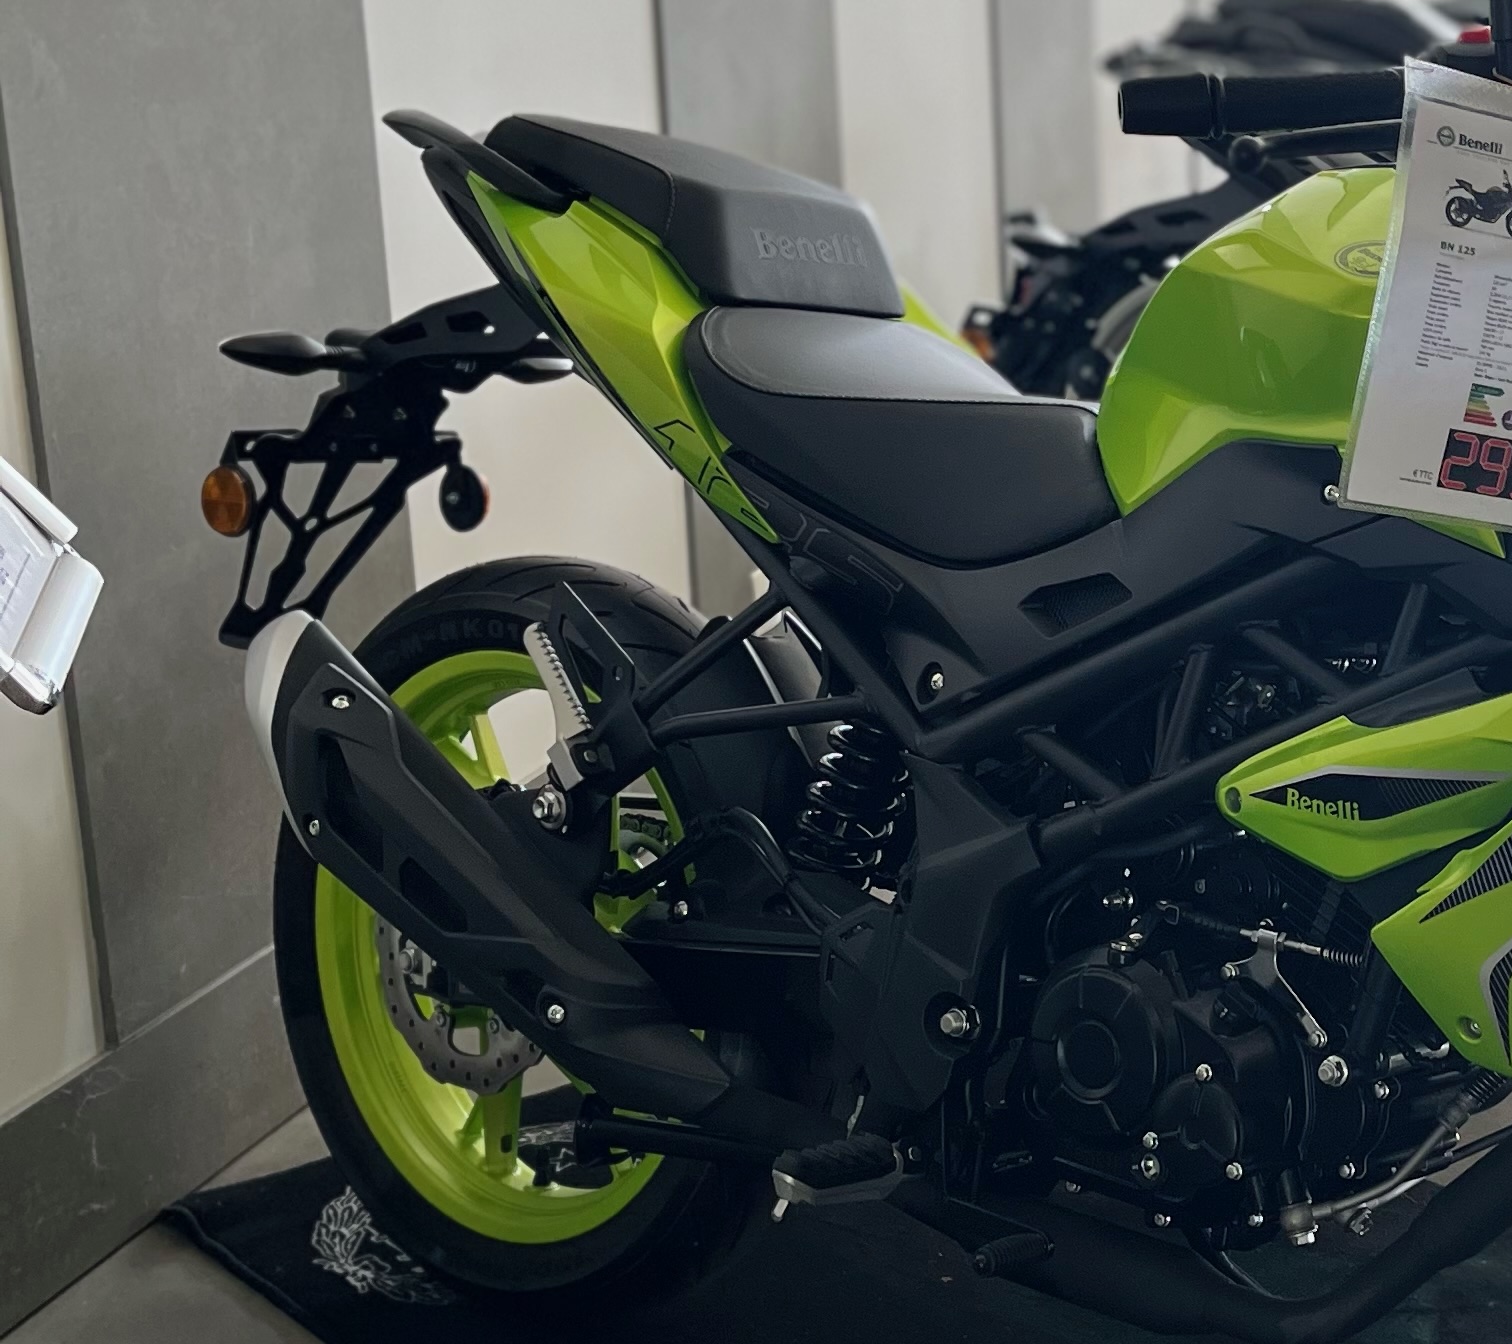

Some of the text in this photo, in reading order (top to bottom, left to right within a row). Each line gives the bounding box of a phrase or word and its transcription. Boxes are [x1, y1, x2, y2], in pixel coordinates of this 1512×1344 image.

[1458, 133, 1503, 155] Benelli
[750, 227, 867, 268] Benelli
[1440, 240, 1476, 256] BN 125
[1419, 470, 1434, 480] TTC
[1286, 787, 1360, 822] Benelli
